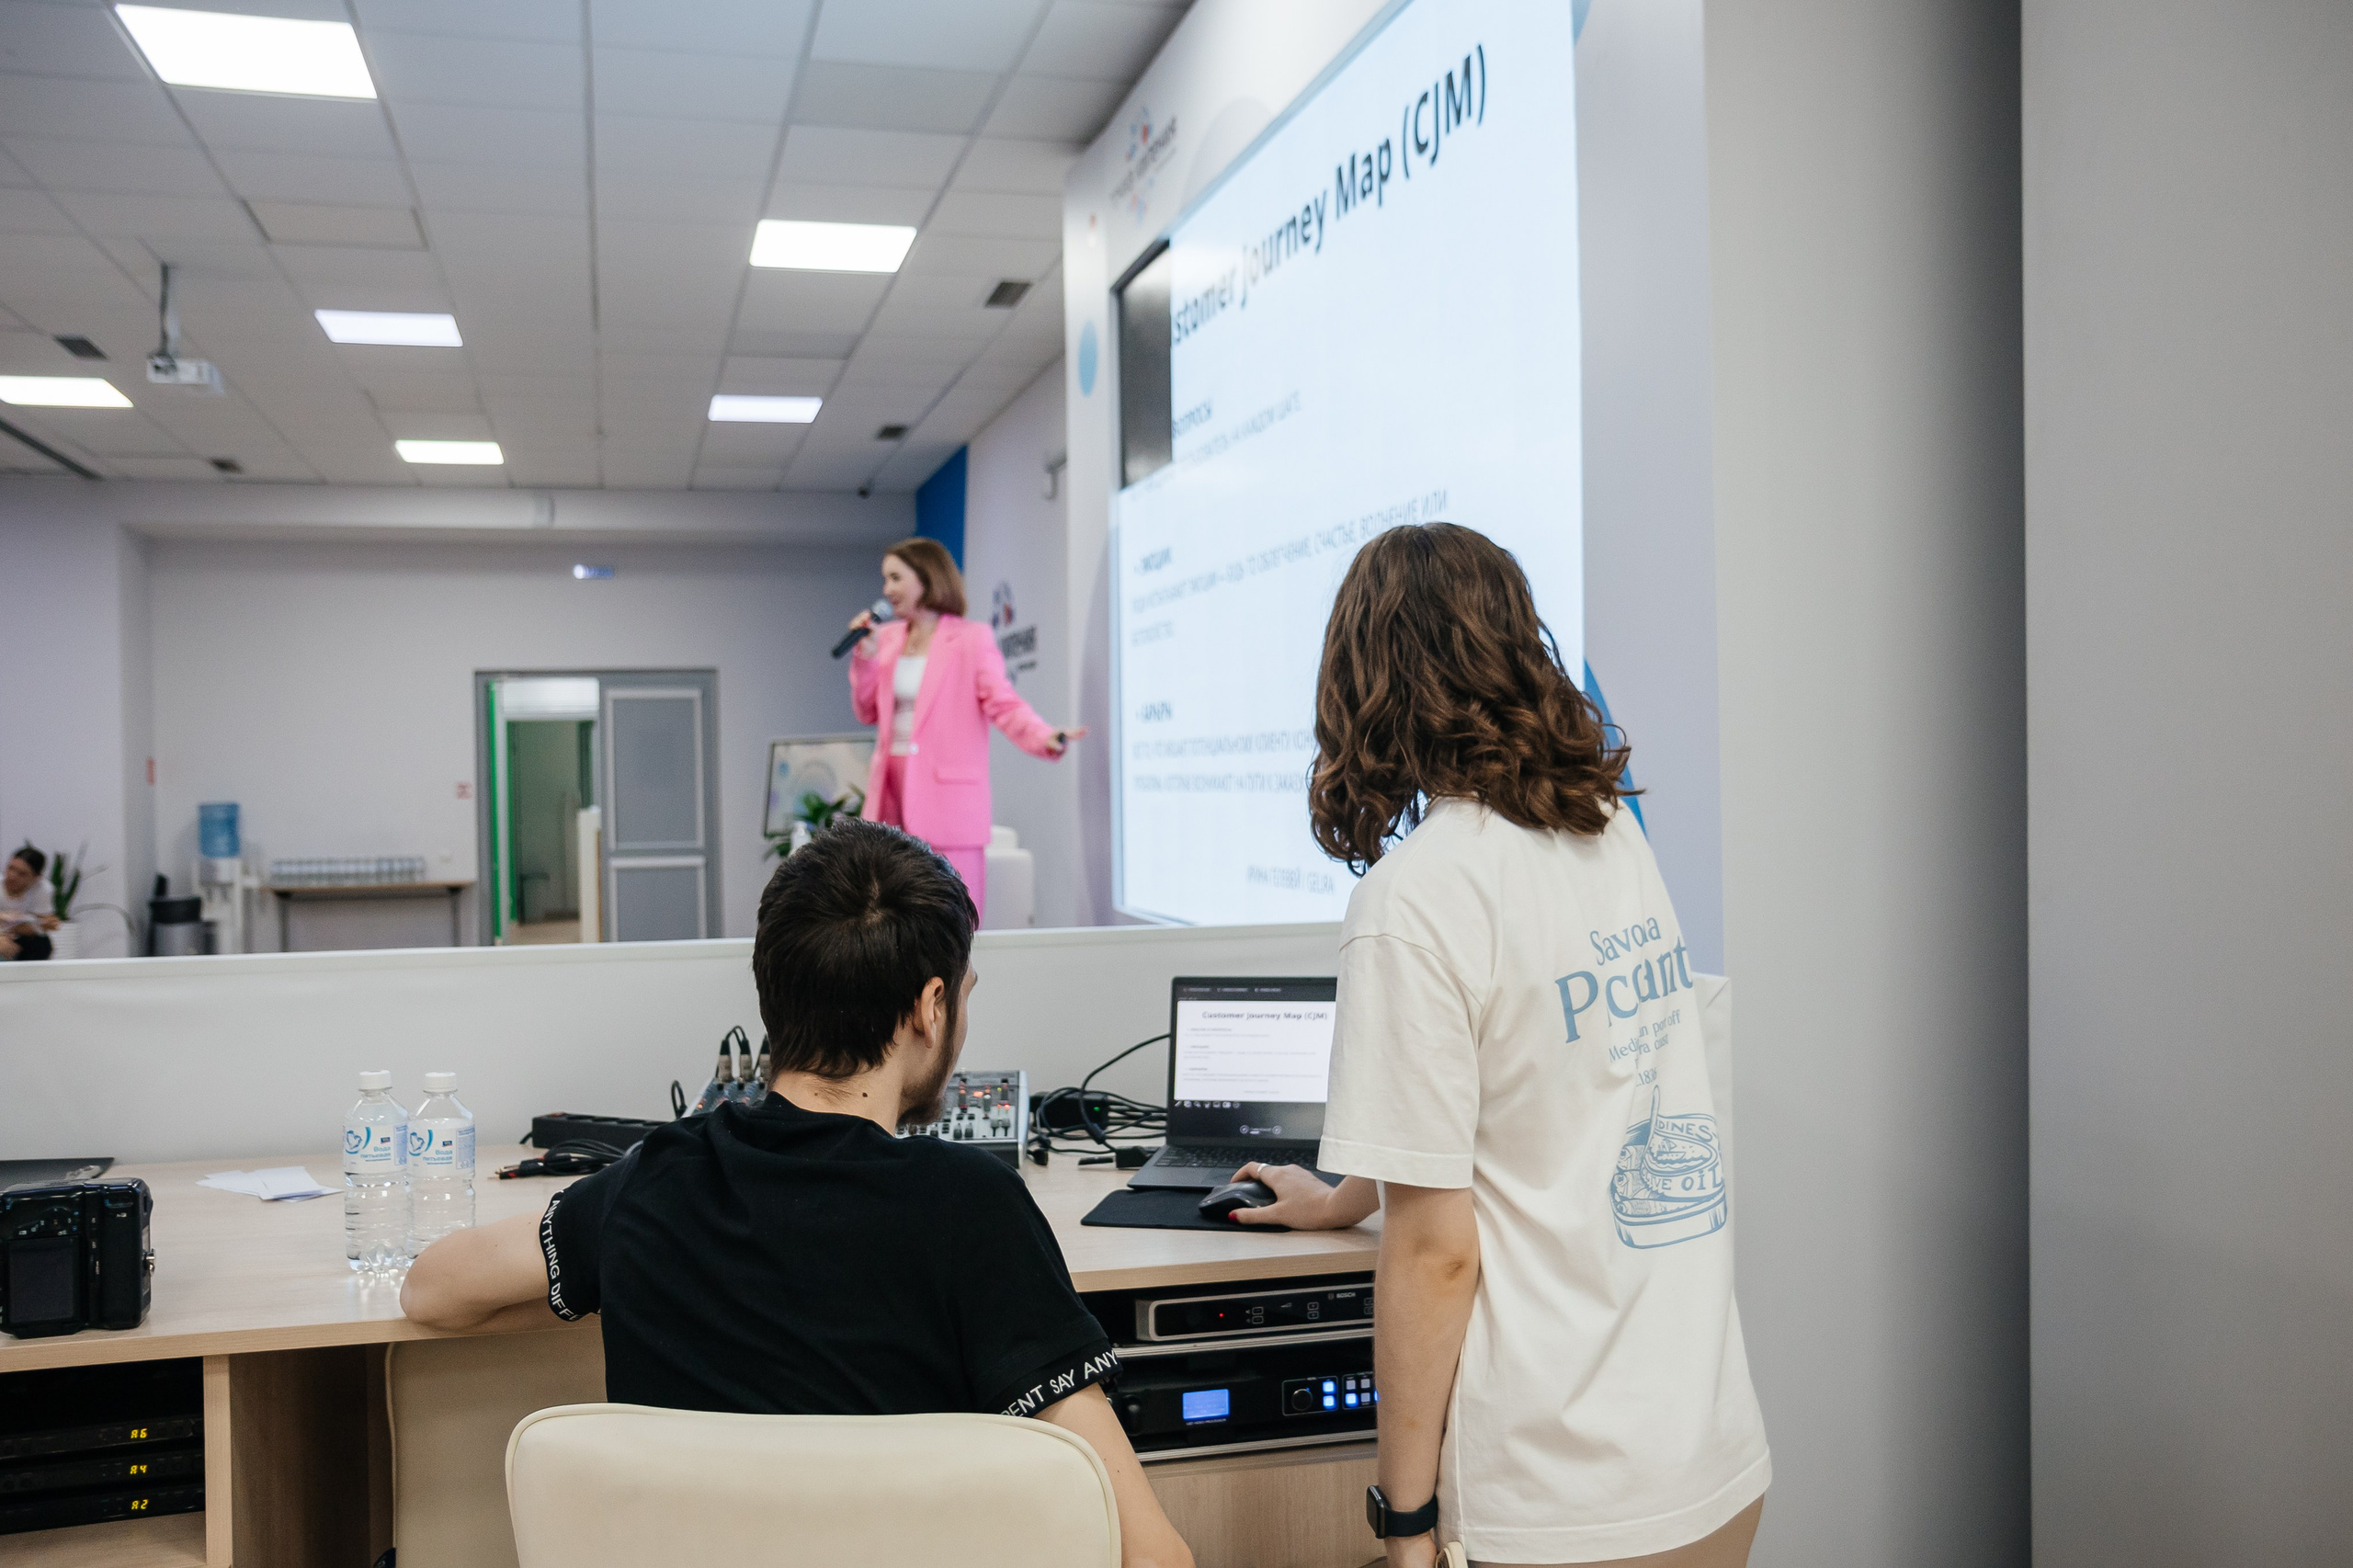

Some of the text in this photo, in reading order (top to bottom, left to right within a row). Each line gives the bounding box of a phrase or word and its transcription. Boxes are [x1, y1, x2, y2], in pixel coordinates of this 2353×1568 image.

[1173, 267, 1236, 346] stomer
[1336, 137, 1392, 221] Map
[1402, 43, 1486, 181] (CJM)
[1201, 1011, 1245, 1019] Customer
[1283, 1012, 1302, 1020] Map
[542, 1199, 561, 1279] ANYTHING
[1000, 1350, 1119, 1417] ENT SAY ANY
